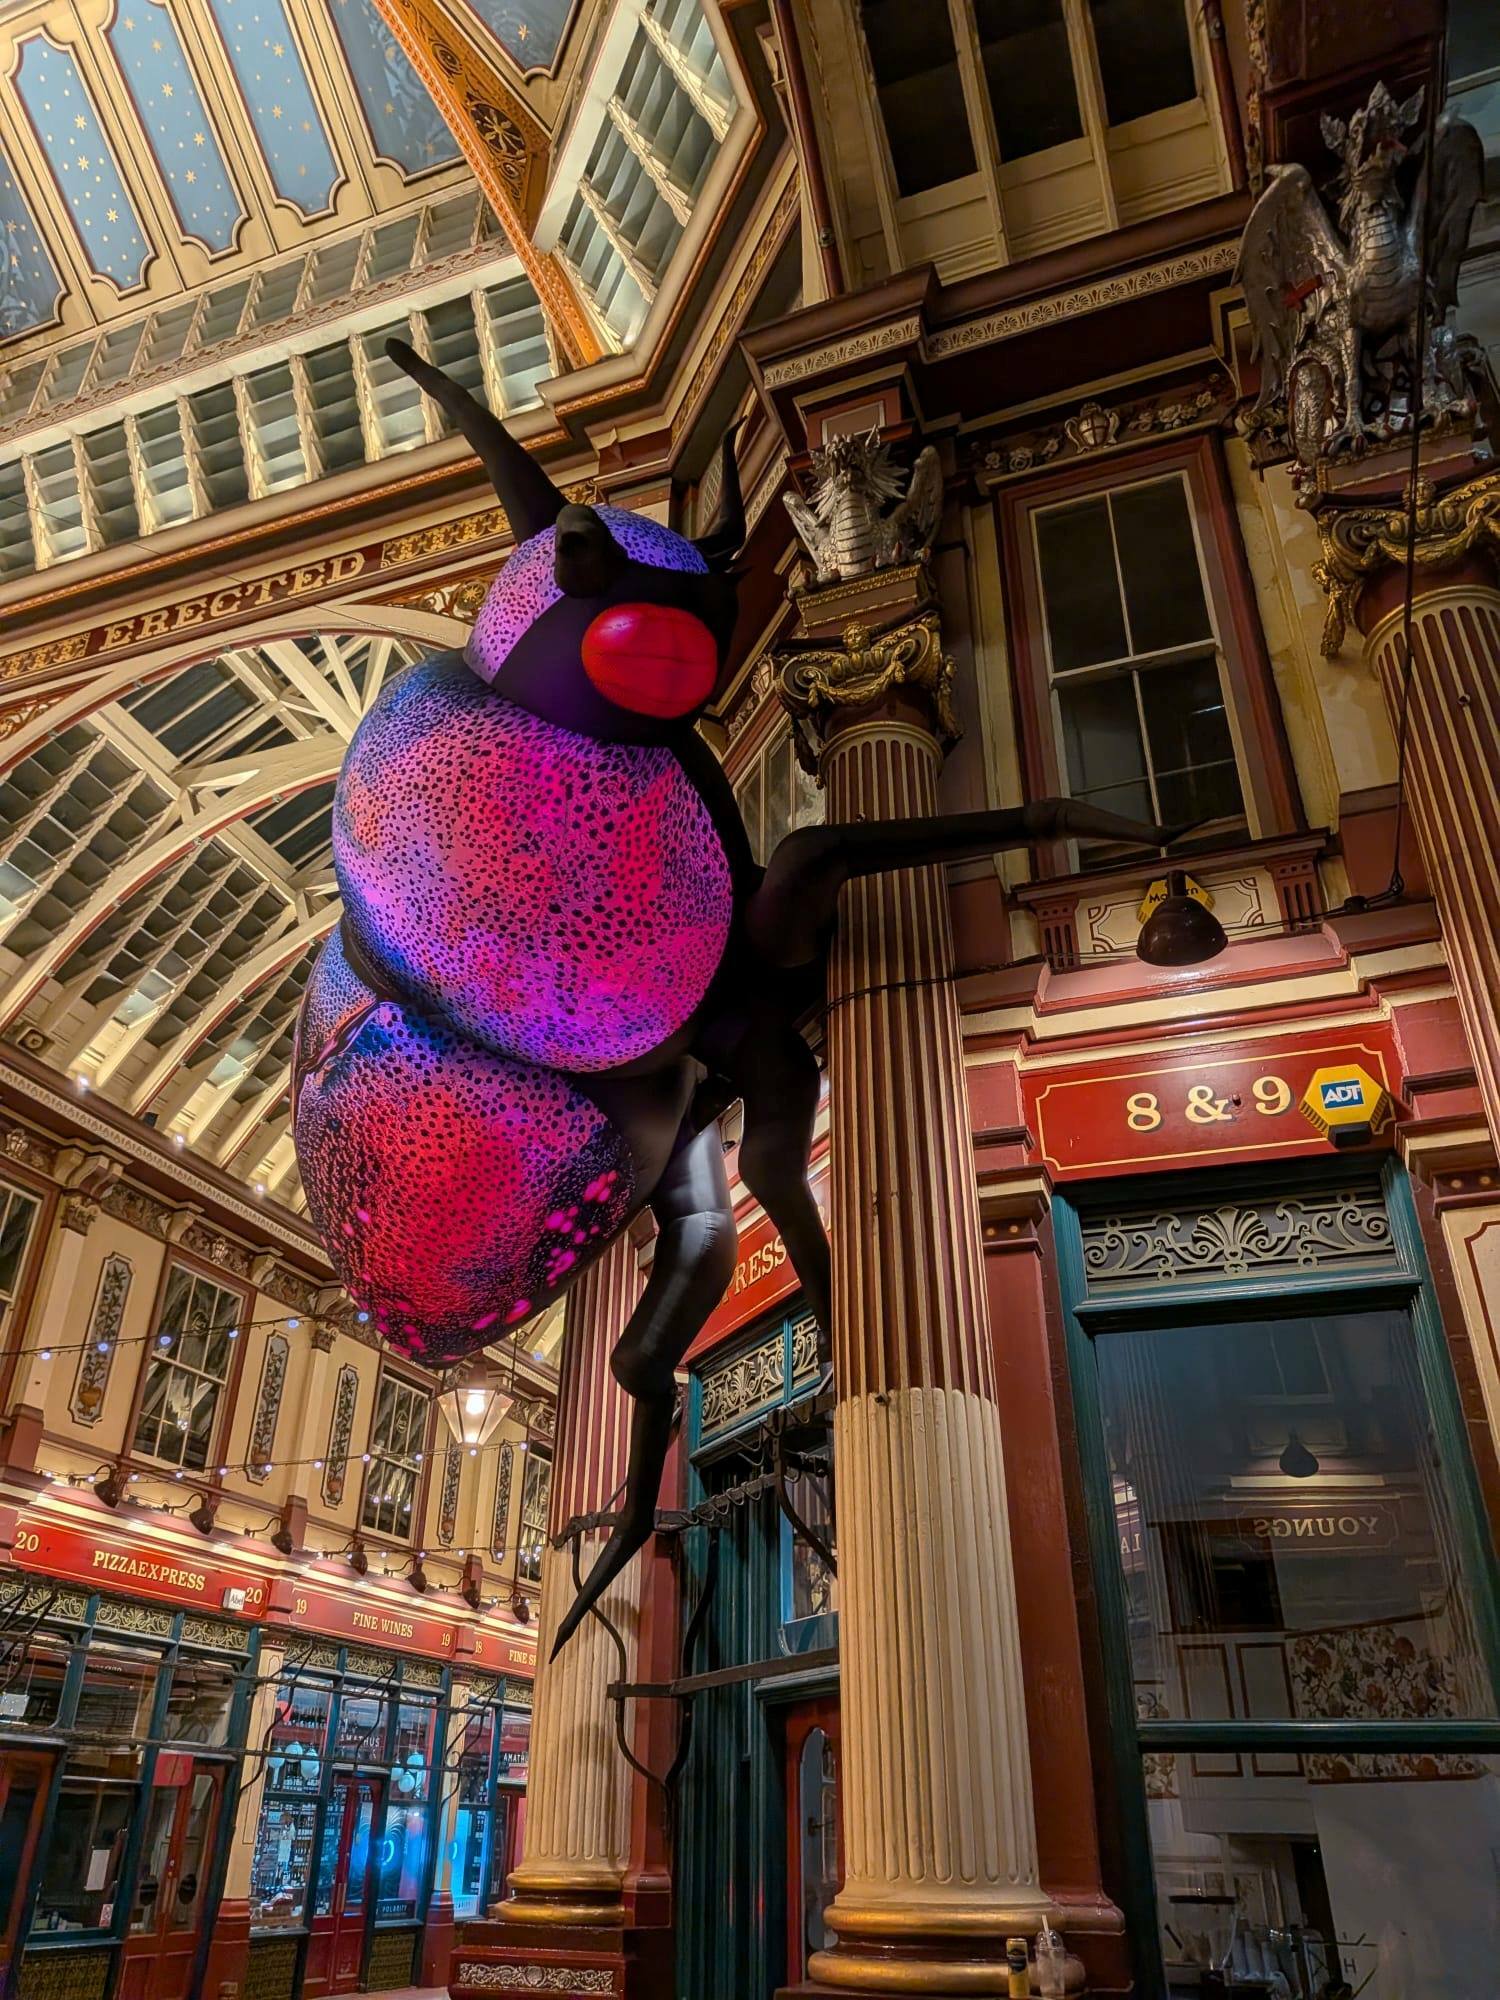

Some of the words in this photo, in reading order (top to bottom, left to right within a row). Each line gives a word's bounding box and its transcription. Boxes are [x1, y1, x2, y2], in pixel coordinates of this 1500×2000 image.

[99, 551, 365, 651] ERECTED
[1149, 887, 1198, 904] Morn
[1126, 1092, 1162, 1132] 8
[1185, 1085, 1233, 1124] &
[1251, 1076, 1292, 1116] 9
[1323, 1085, 1361, 1104] ADT
[15, 1531, 40, 1552] 20
[92, 1550, 206, 1592] PIZZAEXPRESS
[245, 1587, 263, 1605] 20
[295, 1599, 308, 1615] 19
[353, 1612, 378, 1630] FINE
[381, 1618, 413, 1638] WINES
[441, 1633, 451, 1647] 19
[475, 1640, 483, 1654] 18
[509, 1649, 527, 1664] FINE
